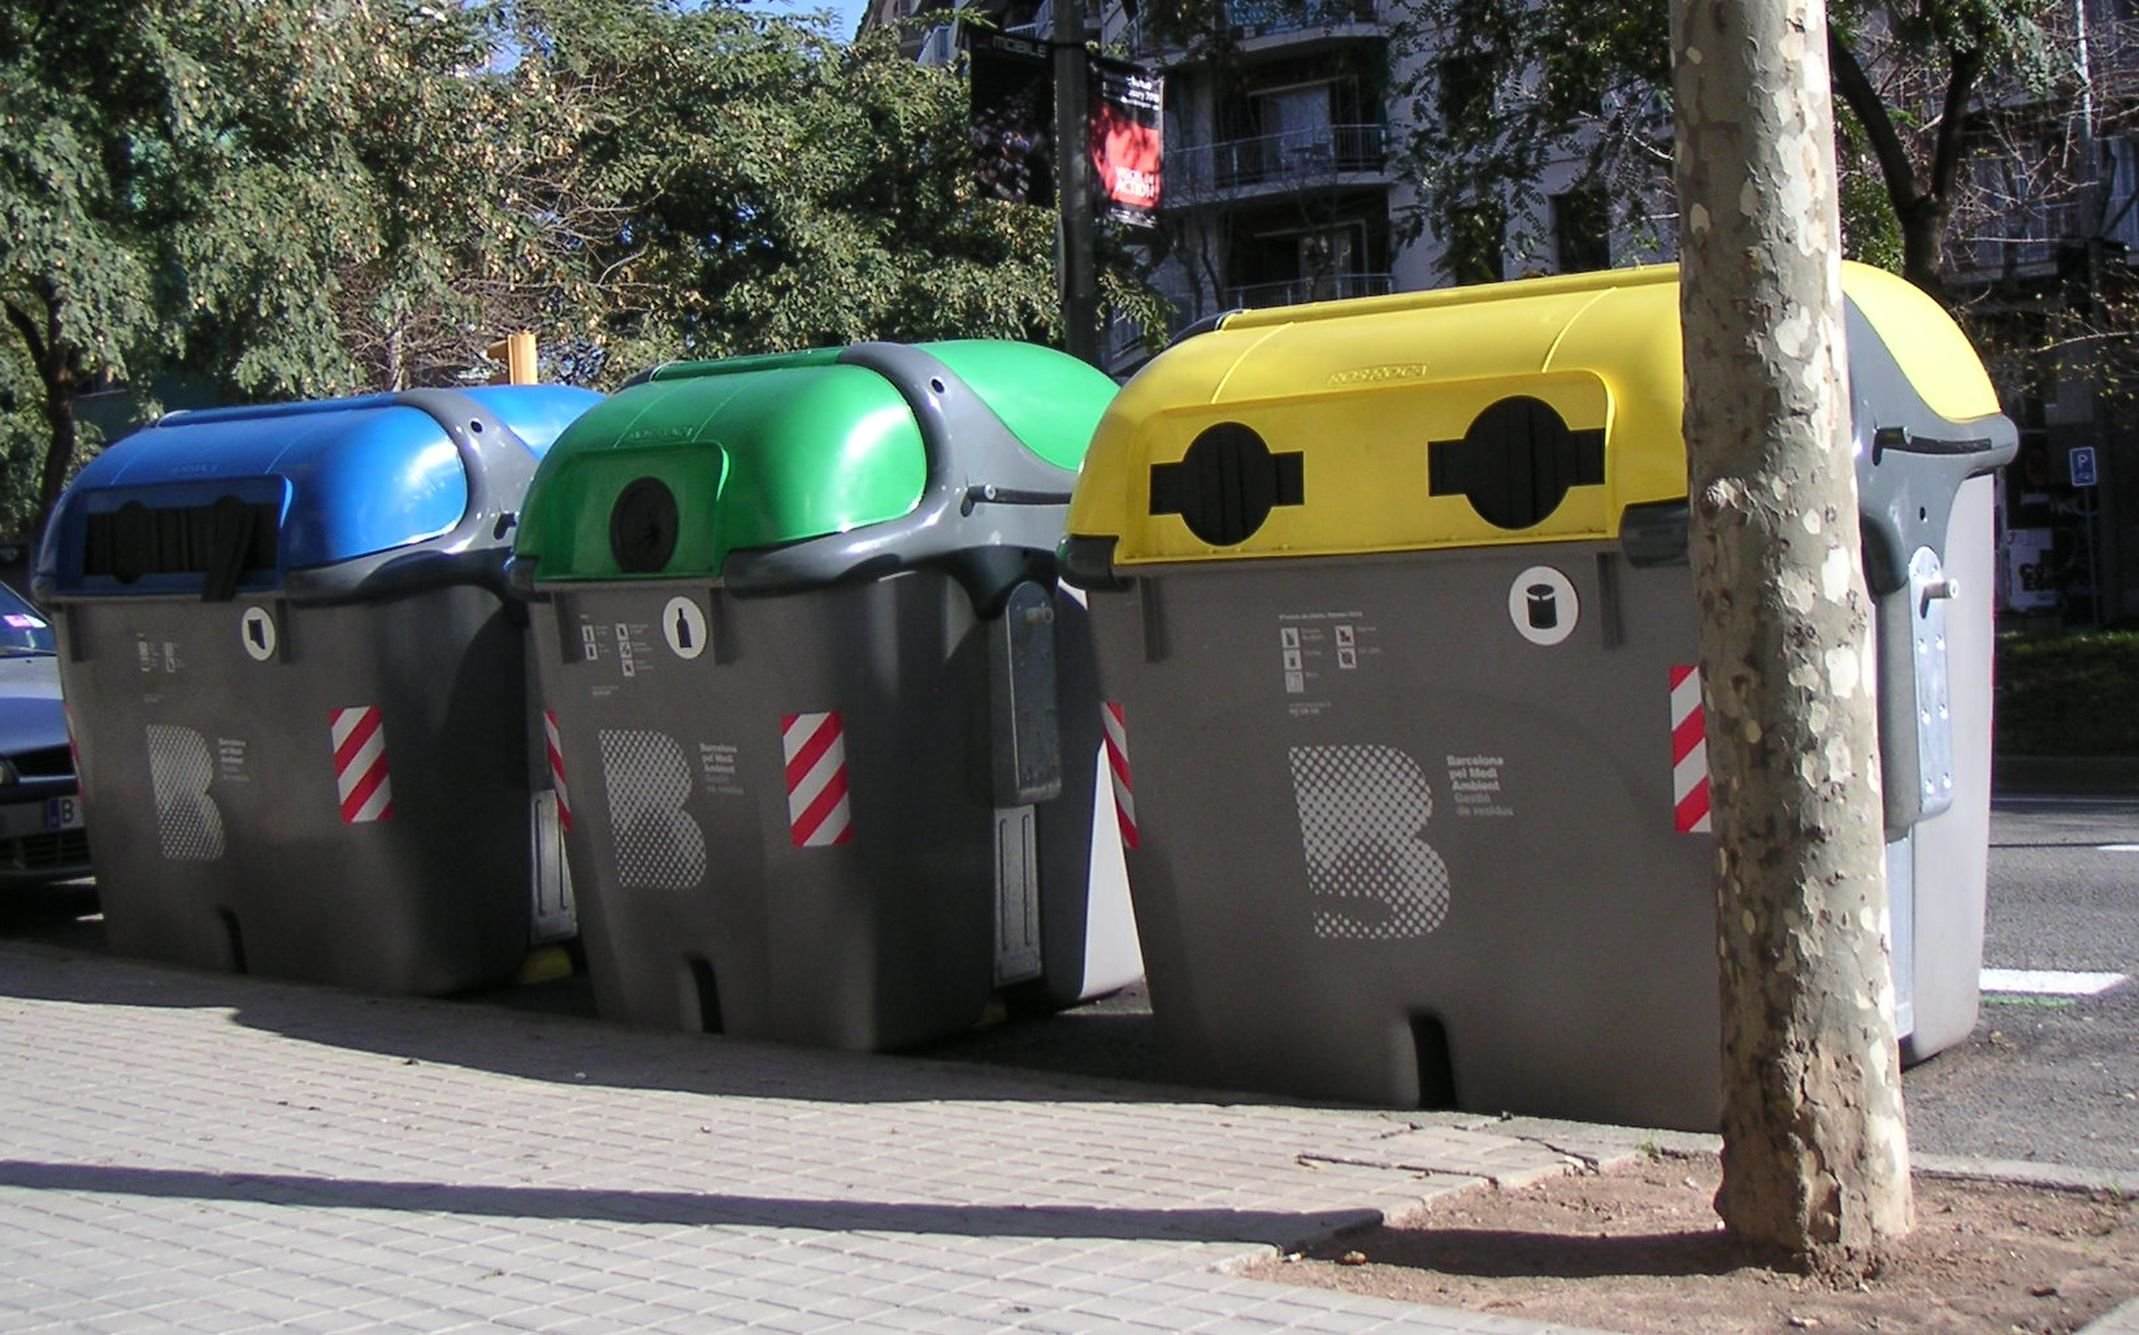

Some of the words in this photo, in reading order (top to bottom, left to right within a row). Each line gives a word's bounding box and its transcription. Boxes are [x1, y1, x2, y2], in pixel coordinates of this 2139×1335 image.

[2078, 454, 2088, 468] P
[1446, 755, 1504, 766] Barcelona
[1449, 768, 1467, 780] pel
[1469, 768, 1498, 778] Medi
[1452, 781, 1500, 791] Ambient
[1289, 745, 1450, 939] B
